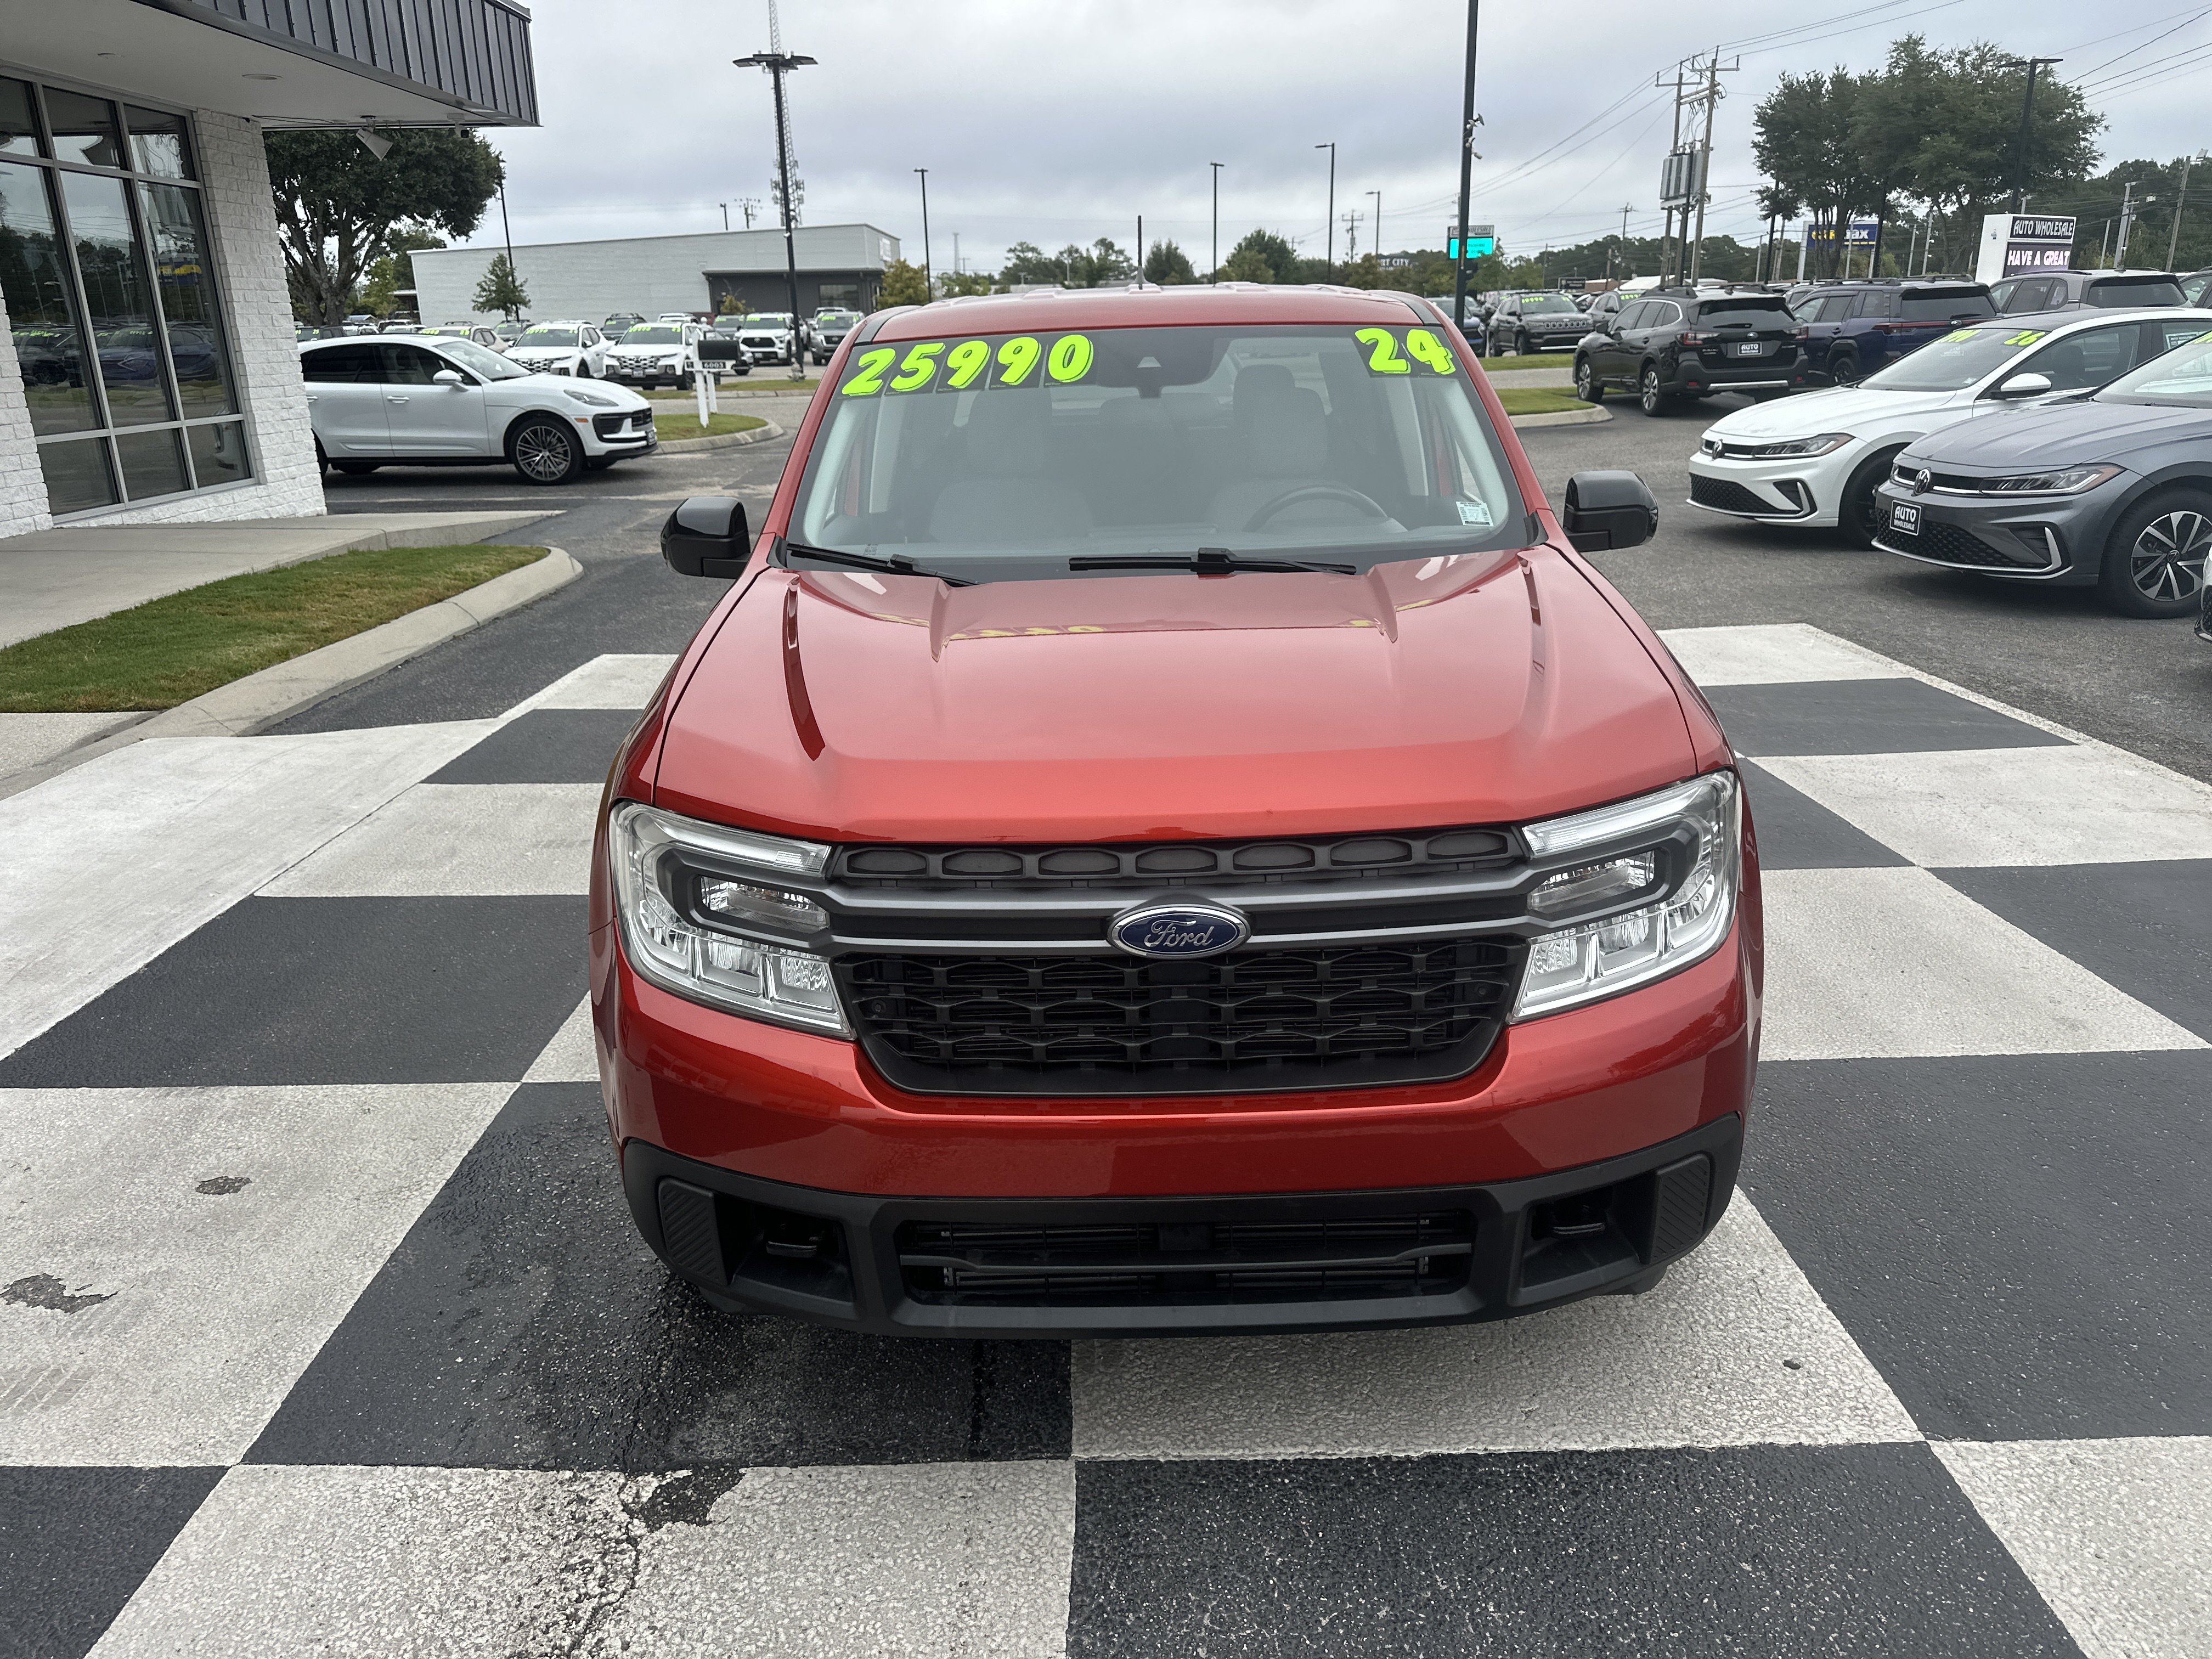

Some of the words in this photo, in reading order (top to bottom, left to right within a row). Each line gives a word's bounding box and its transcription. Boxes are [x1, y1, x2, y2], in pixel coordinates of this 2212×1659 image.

[2013, 220, 2034, 235] AUTO
[2035, 221, 2074, 237] WHOLESALE
[2007, 250, 2033, 266] HAVE
[2034, 251, 2041, 266] A
[2043, 251, 2070, 266] GREAT
[2003, 330, 2046, 346] 26
[1355, 328, 1456, 375] 24
[842, 334, 1093, 397] 25990
[1894, 505, 1916, 522] AUTO
[1894, 519, 1915, 531] WHOLESALE
[1144, 919, 1215, 947] Ford
